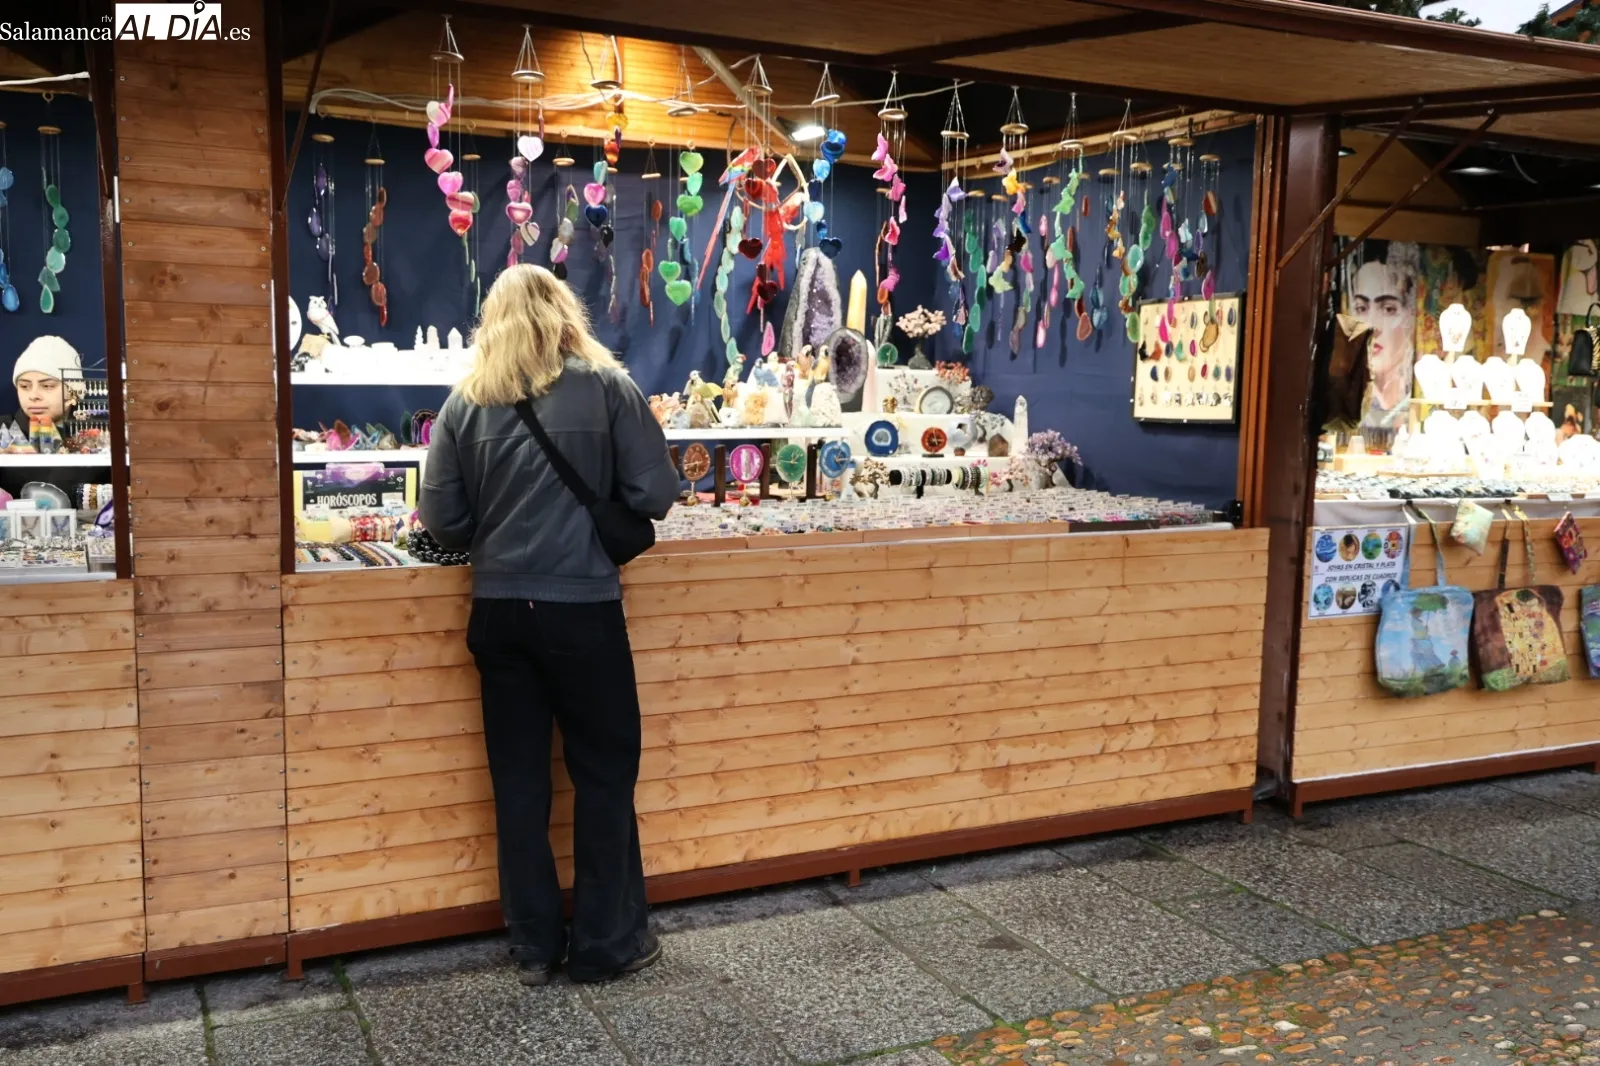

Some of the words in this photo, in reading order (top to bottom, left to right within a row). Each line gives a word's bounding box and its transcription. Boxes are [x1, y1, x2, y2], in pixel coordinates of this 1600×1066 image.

[317, 492, 377, 507] HORÓSCOPOS
[1354, 562, 1374, 570] CRISTAL
[1338, 574, 1363, 582] REPLICAS
[1372, 572, 1398, 580] CUADROS
